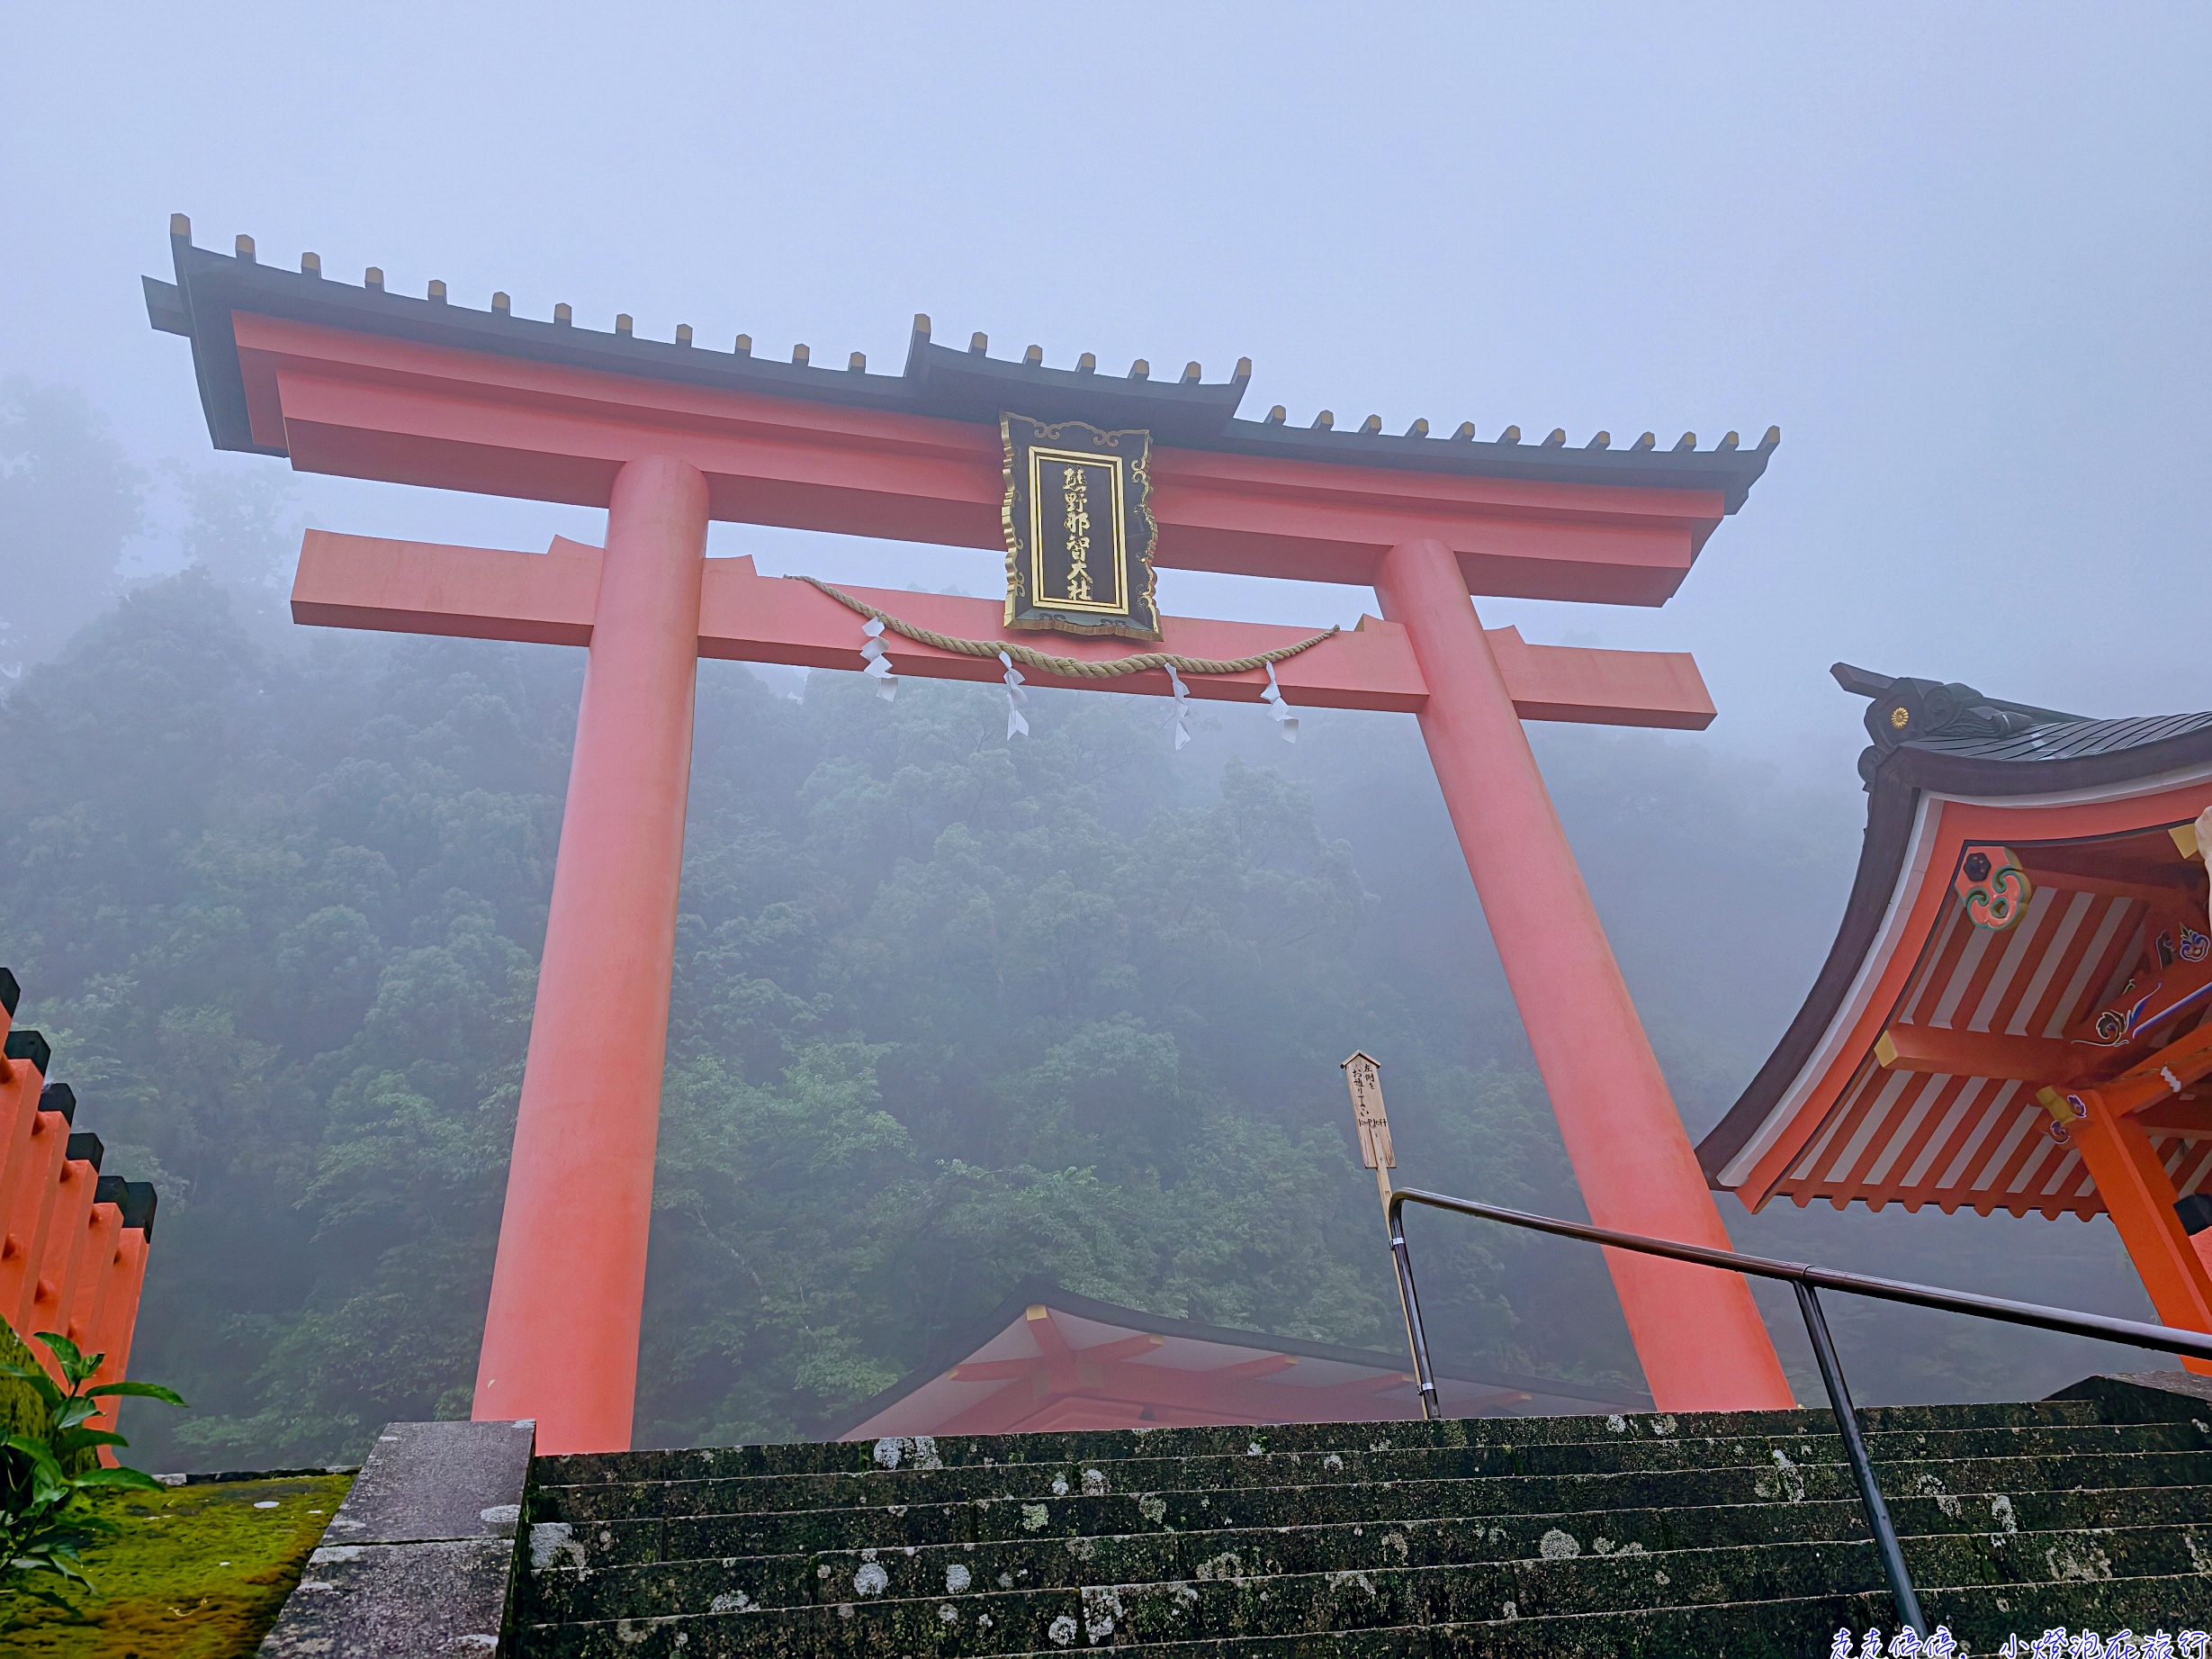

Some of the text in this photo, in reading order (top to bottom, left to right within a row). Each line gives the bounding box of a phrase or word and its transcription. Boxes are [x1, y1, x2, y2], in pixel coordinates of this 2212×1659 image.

[1063, 464, 1093, 601] 熊野那智大社
